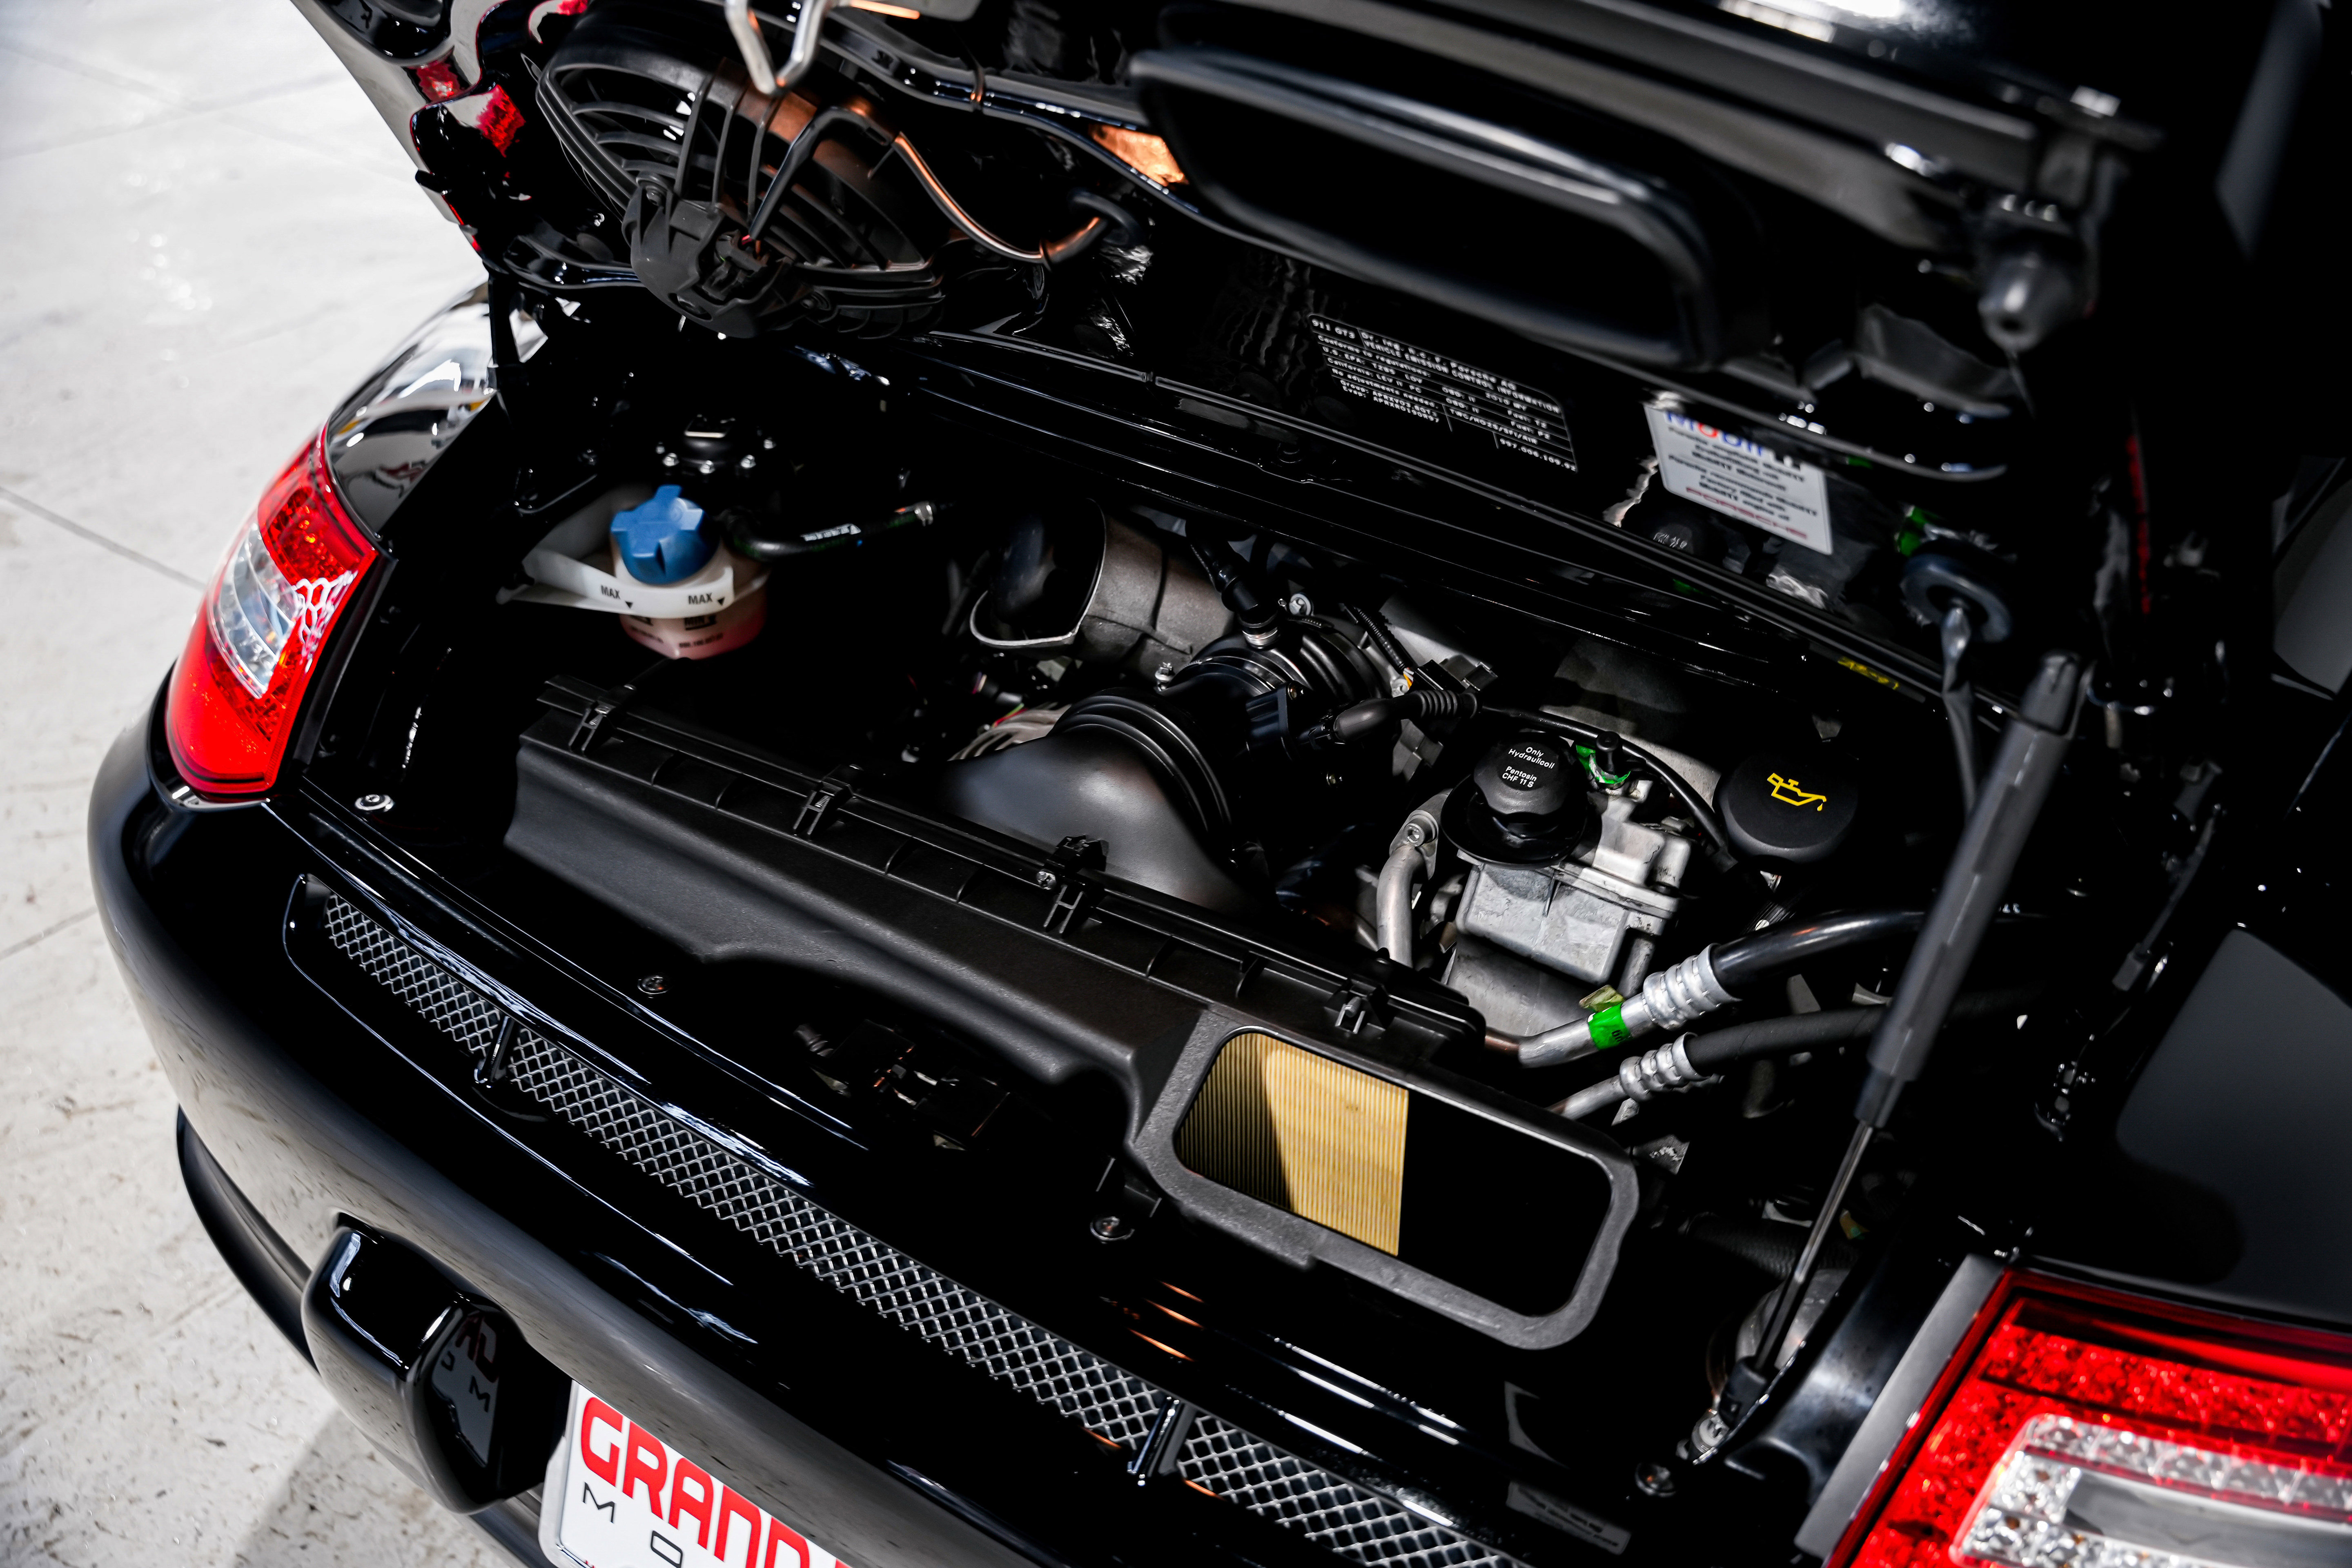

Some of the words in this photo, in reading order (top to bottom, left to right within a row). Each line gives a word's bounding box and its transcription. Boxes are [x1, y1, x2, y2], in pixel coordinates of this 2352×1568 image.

[1312, 318, 1330, 331] 911
[1335, 327, 1355, 339] GT3
[1318, 334, 1360, 353] Conforms
[1327, 357, 1373, 377] California:
[1376, 374, 1393, 383] LEV
[1409, 385, 1421, 393] PC
[1363, 341, 1401, 358] VEHICLE
[1452, 370, 1493, 390] CONTROL
[1497, 387, 1559, 414] INFORMATION
[1332, 368, 1343, 376] No
[1347, 374, 1400, 395] adjustments
[1403, 393, 1438, 409] needed.
[1340, 379, 1369, 393] Group:
[1342, 385, 1366, 398] Evap:
[1501, 380, 1516, 391] AG
[1442, 387, 1464, 399] OBD:
[1446, 397, 1468, 410] OBD:
[1485, 392, 1510, 405] 2010
[1513, 402, 1527, 411] MY
[601, 585, 620, 599] MAX
[688, 593, 713, 605] MAX
[1526, 747, 1544, 758] Only
[1502, 773, 1519, 782] CHF
